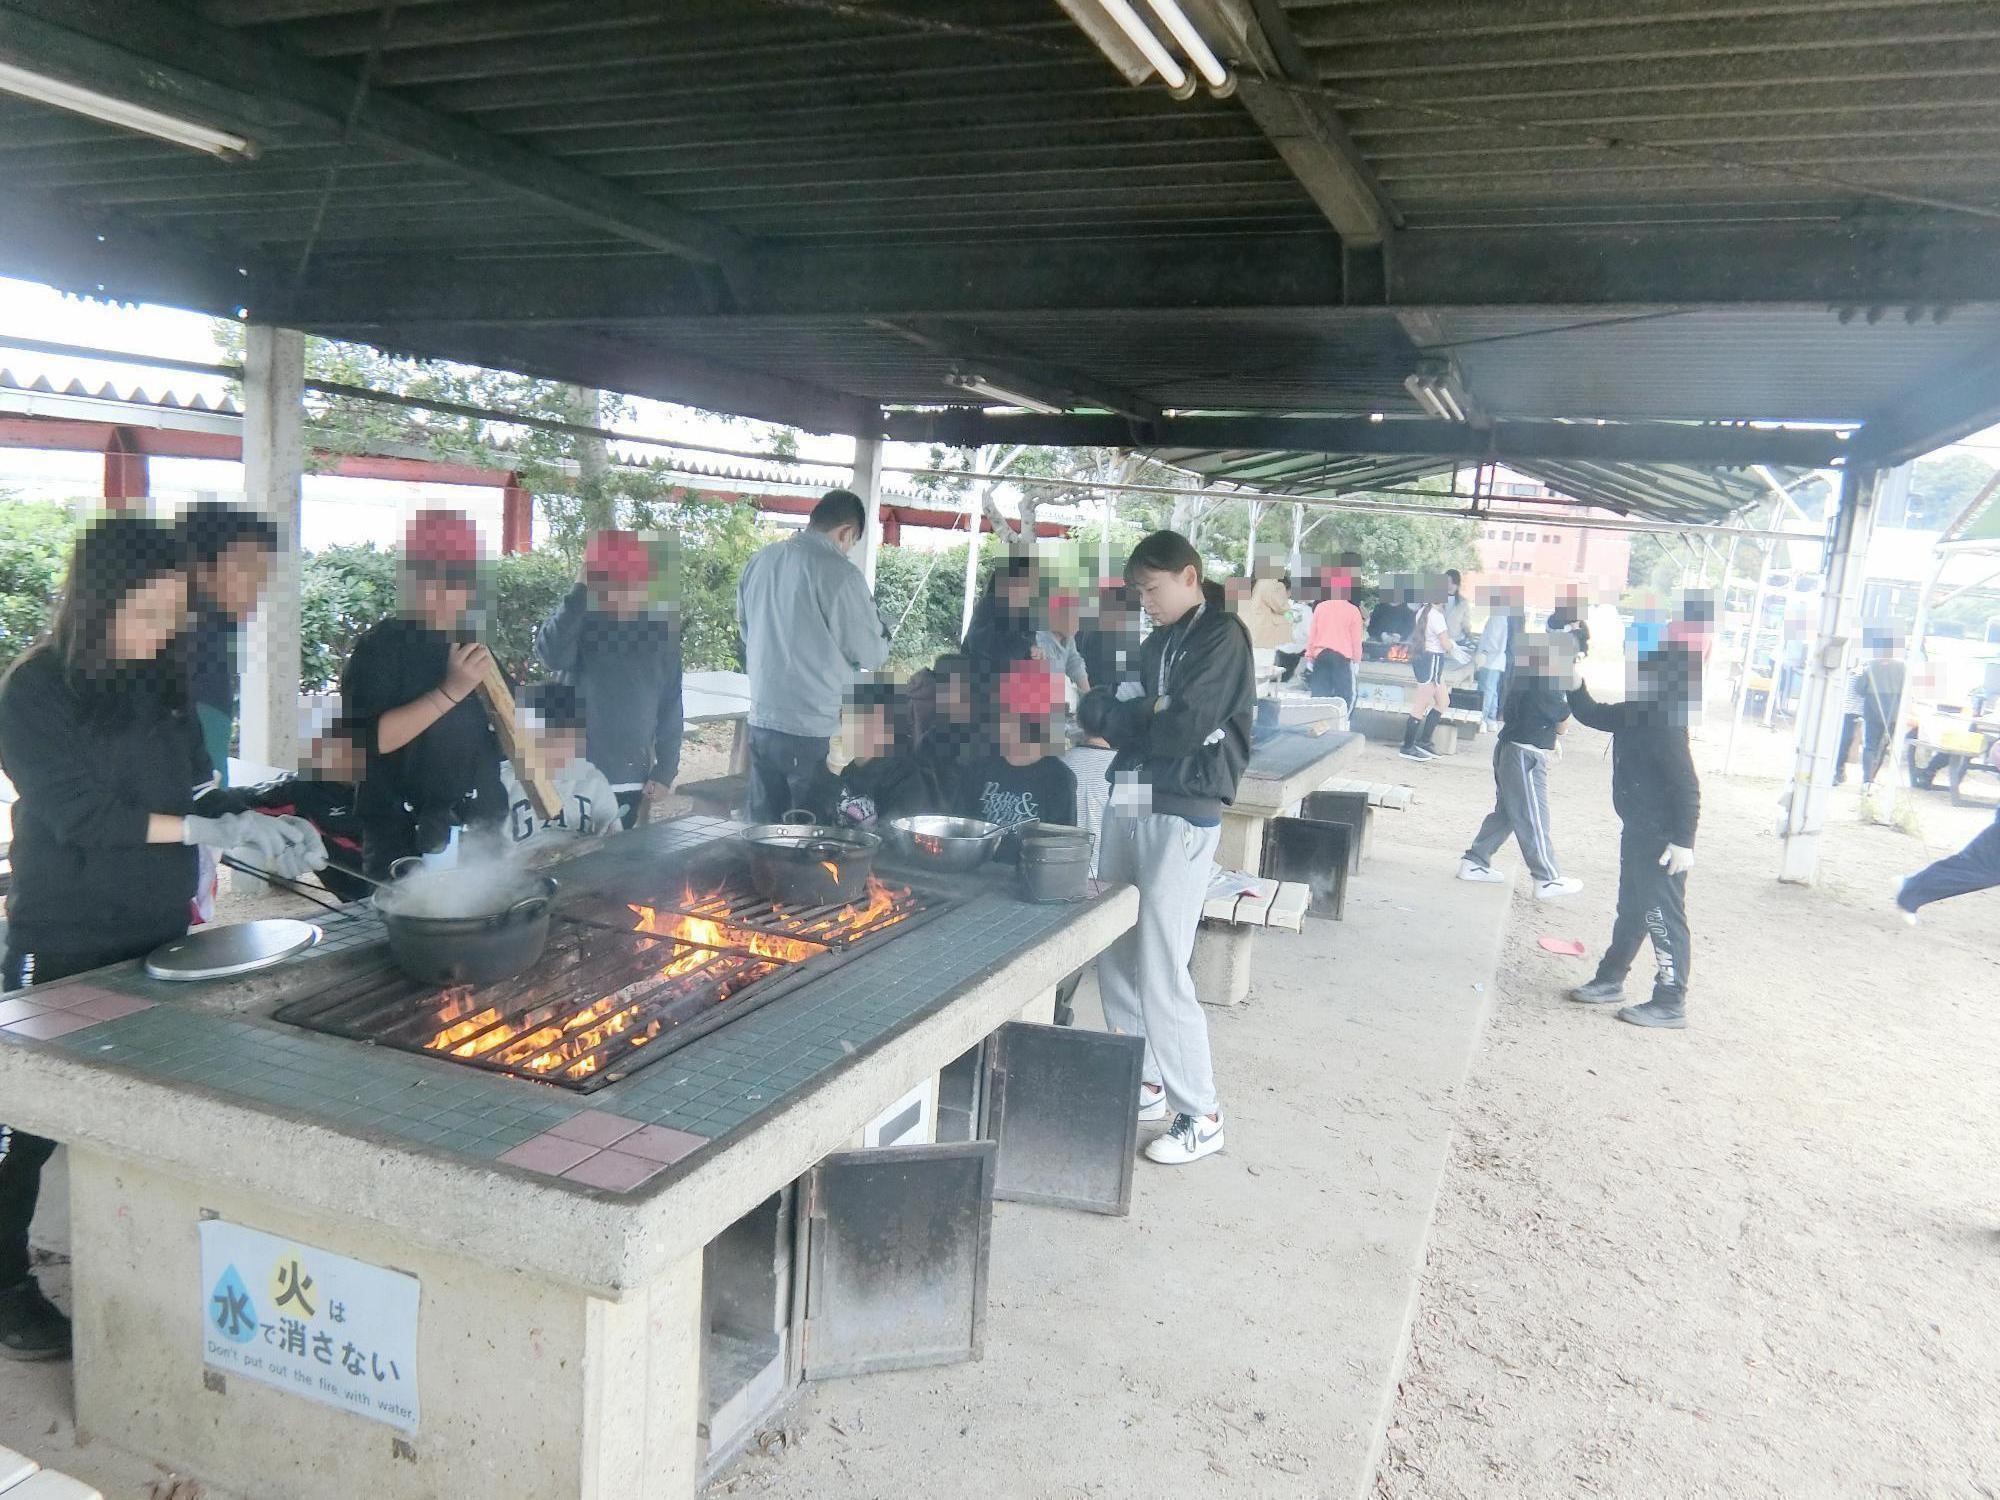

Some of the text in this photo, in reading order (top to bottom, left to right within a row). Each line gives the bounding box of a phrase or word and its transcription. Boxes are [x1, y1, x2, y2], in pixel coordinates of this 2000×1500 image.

[1646, 907, 1675, 986] NEW OR
[275, 1260, 346, 1323] 火は
[213, 1284, 400, 1382] 水で消さない
[207, 1340, 416, 1422] Don't put out the fire with water.
